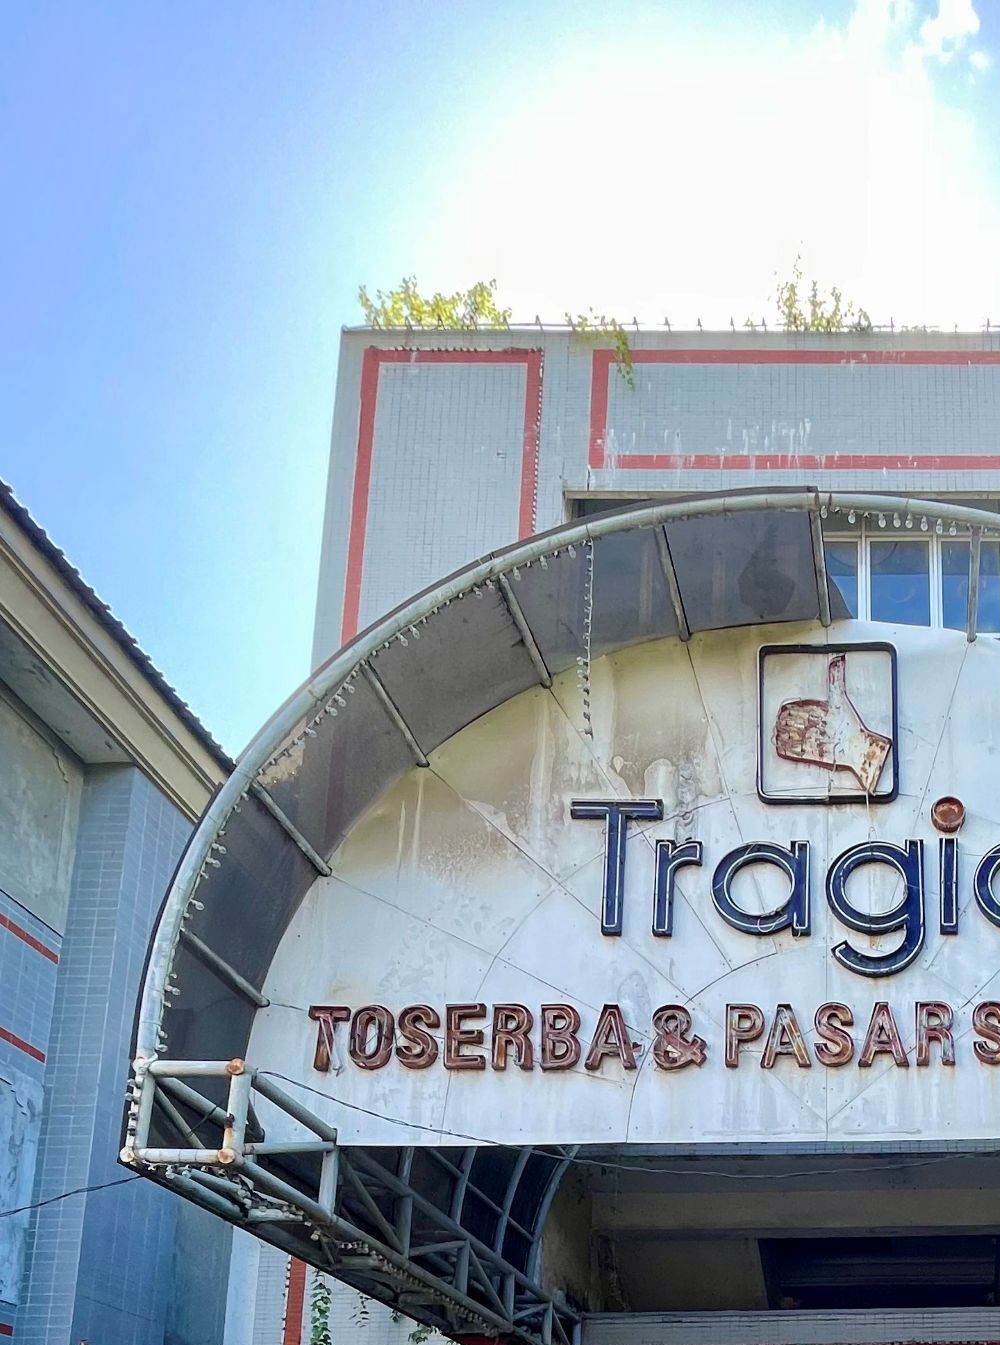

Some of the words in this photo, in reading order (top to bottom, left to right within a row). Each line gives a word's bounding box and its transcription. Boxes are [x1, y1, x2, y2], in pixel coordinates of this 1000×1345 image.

[308, 1002, 637, 1073] TOSERBA
[652, 1003, 707, 1071] &
[724, 1001, 956, 1068] PASAR
